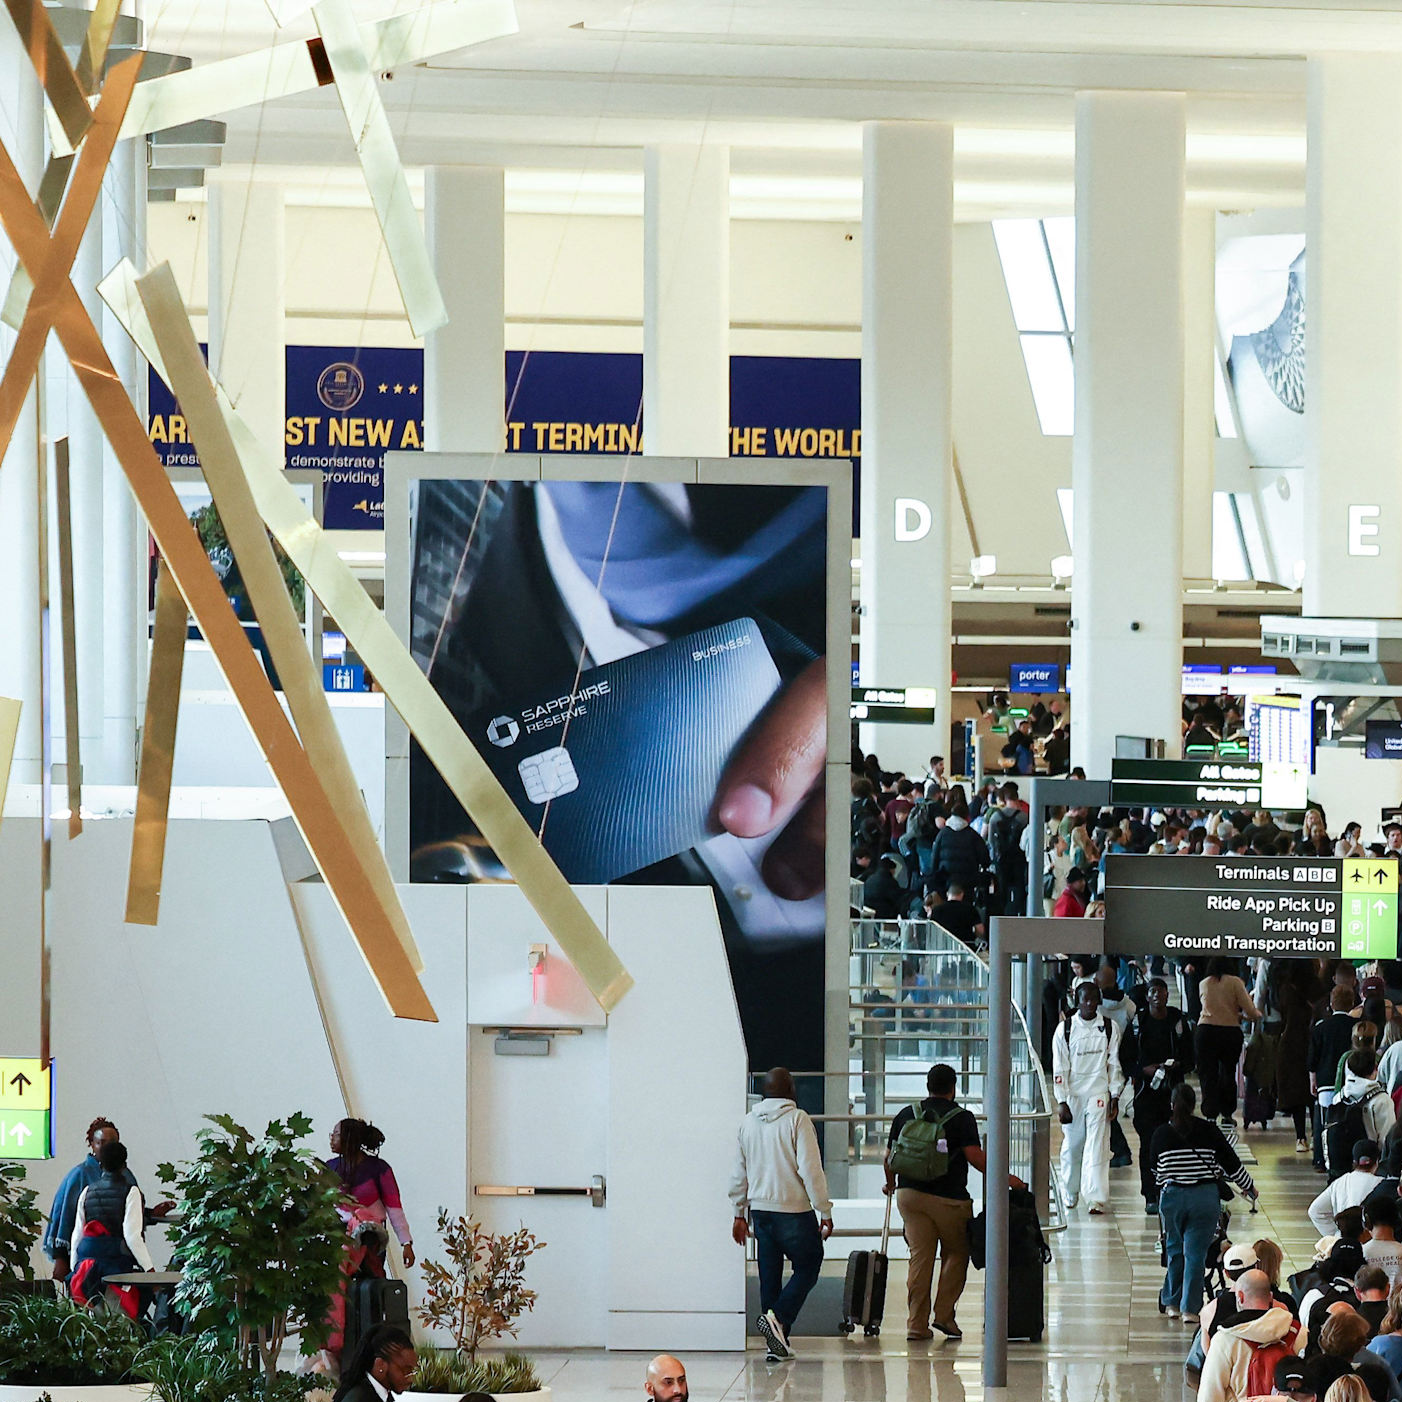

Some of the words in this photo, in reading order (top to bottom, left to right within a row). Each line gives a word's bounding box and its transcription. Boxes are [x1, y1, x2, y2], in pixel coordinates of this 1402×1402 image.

[328, 417, 394, 448] NEW
[533, 422, 643, 452] TERMIN
[730, 427, 767, 456] HE
[290, 455, 375, 468] demonstrate
[894, 499, 932, 542] D
[1348, 505, 1381, 556] E
[692, 635, 751, 662] BUSINESS
[1019, 670, 1050, 682] porter
[521, 680, 611, 722] SAPPHIRE
[526, 704, 587, 735] RESERVE
[1216, 864, 1290, 881] Terminals
[1207, 896, 1241, 910] Ride
[1244, 896, 1276, 914] App
[1279, 897, 1310, 912] Pick
[1314, 898, 1336, 915] Up
[1262, 917, 1319, 936] Parking
[1164, 934, 1221, 949] Ground
[1224, 935, 1335, 953] Transportation
